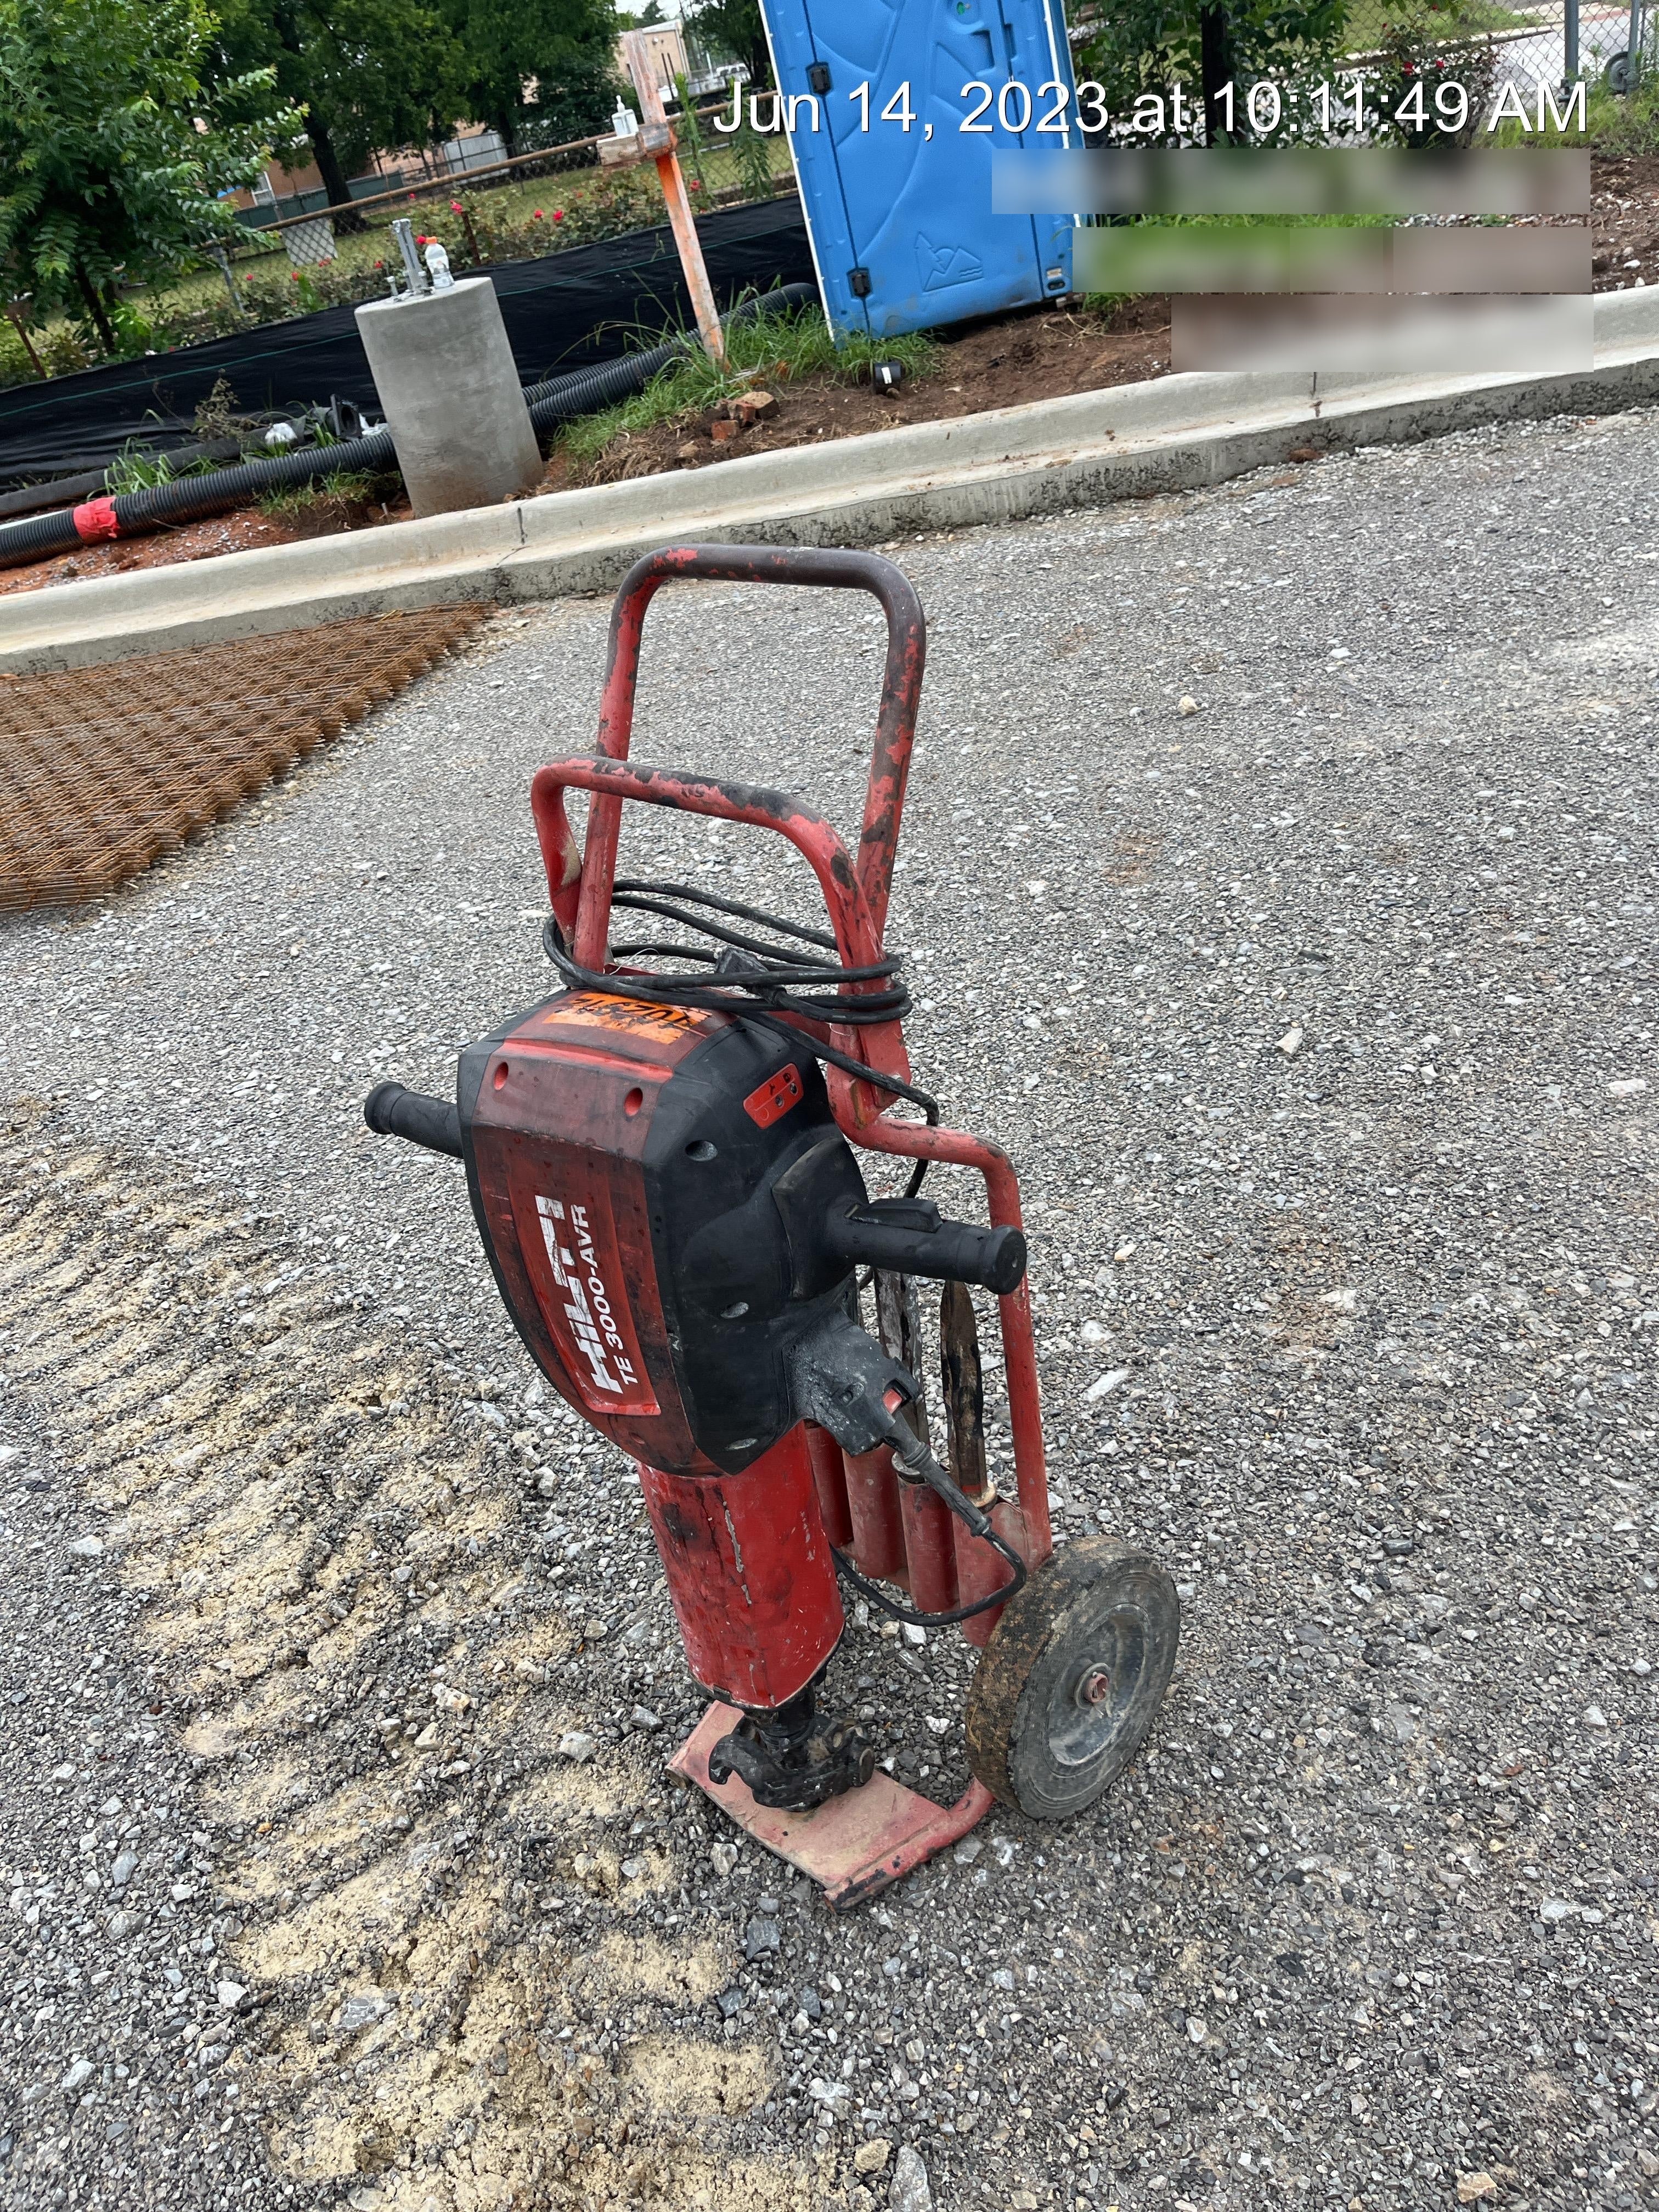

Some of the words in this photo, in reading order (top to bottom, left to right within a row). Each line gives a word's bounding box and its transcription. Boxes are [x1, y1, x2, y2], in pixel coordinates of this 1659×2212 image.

[535, 1195, 623, 1393] HILTI
[571, 1204, 624, 1351] 3000-AVR
[613, 1355, 639, 1385] TE
